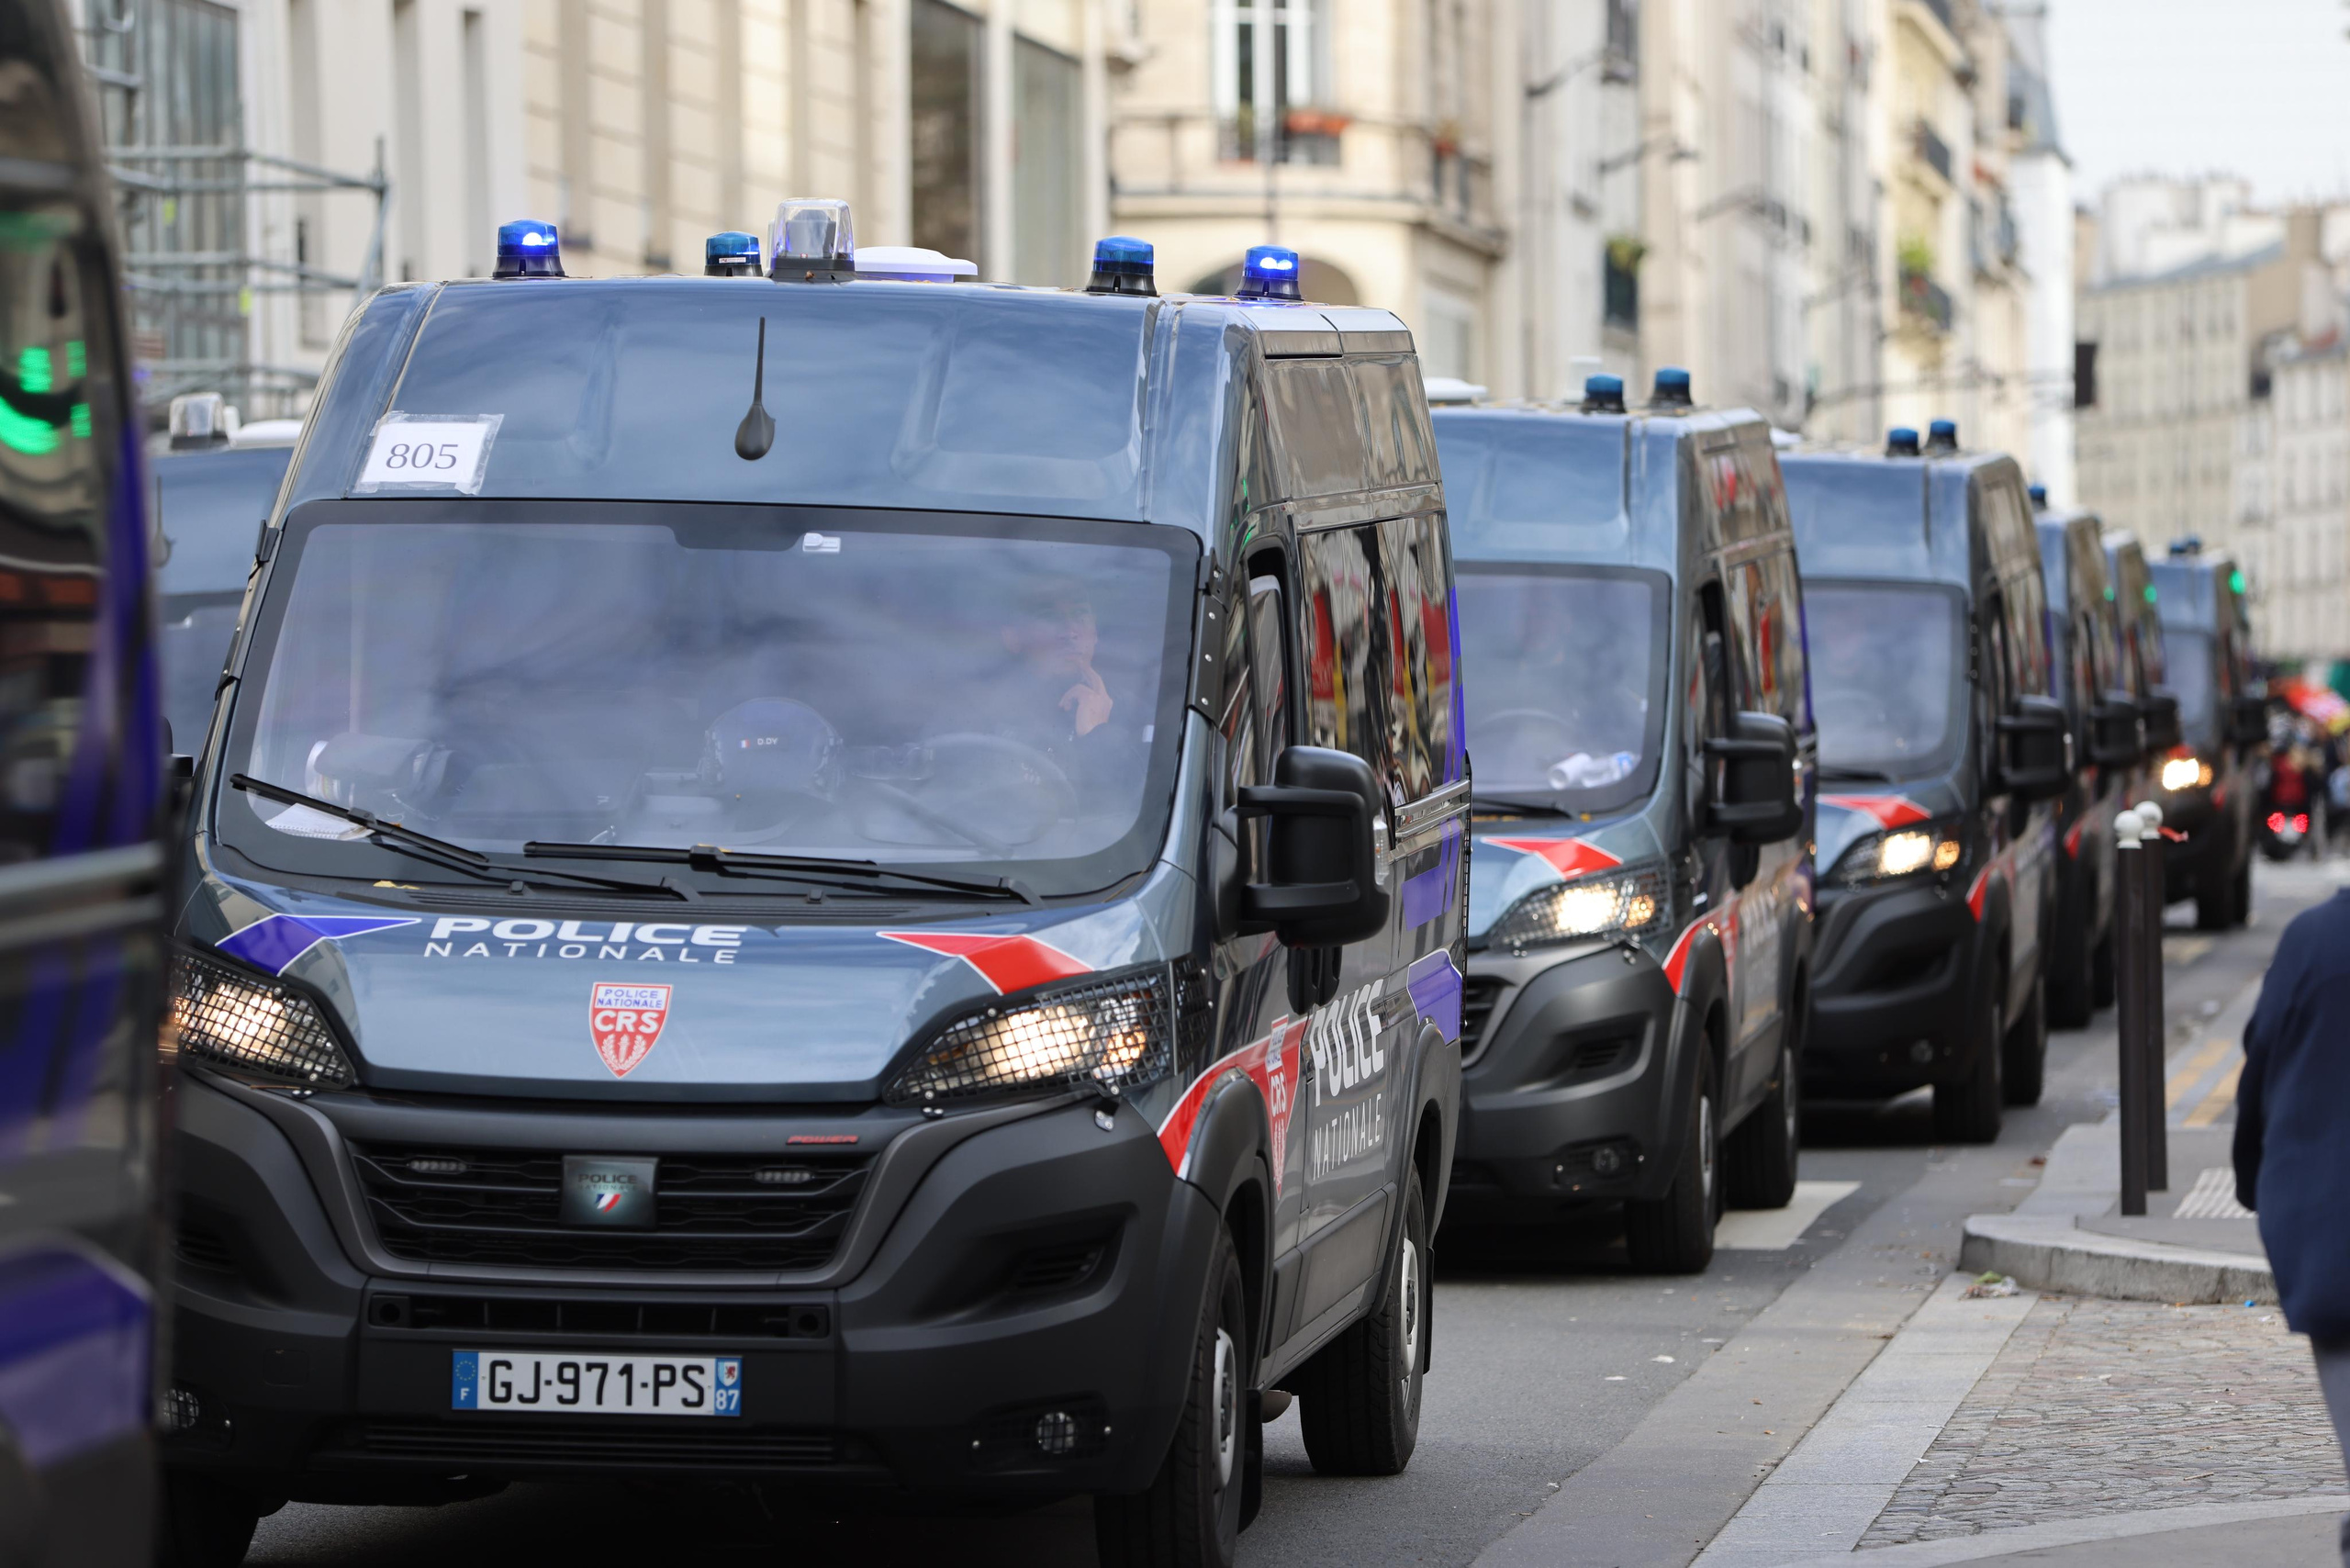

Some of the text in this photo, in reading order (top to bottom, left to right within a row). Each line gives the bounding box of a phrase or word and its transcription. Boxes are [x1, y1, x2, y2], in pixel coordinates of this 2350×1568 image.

[386, 443, 458, 469] 805
[430, 918, 748, 947] POLICE
[423, 942, 738, 964] NATIONALE
[596, 998, 663, 1008] NATIONALE
[604, 989, 659, 999] POLICE
[594, 1010, 659, 1034] CRS
[1309, 979, 1383, 1107] POLICE
[1270, 1070, 1286, 1117] CRS
[787, 1135, 859, 1144] POWER
[1313, 1093, 1382, 1182] NATIONALE
[577, 1174, 638, 1184] POLICE
[460, 1388, 470, 1401] F
[488, 1360, 705, 1408] GJ-971-PS
[715, 1389, 740, 1411] 87
